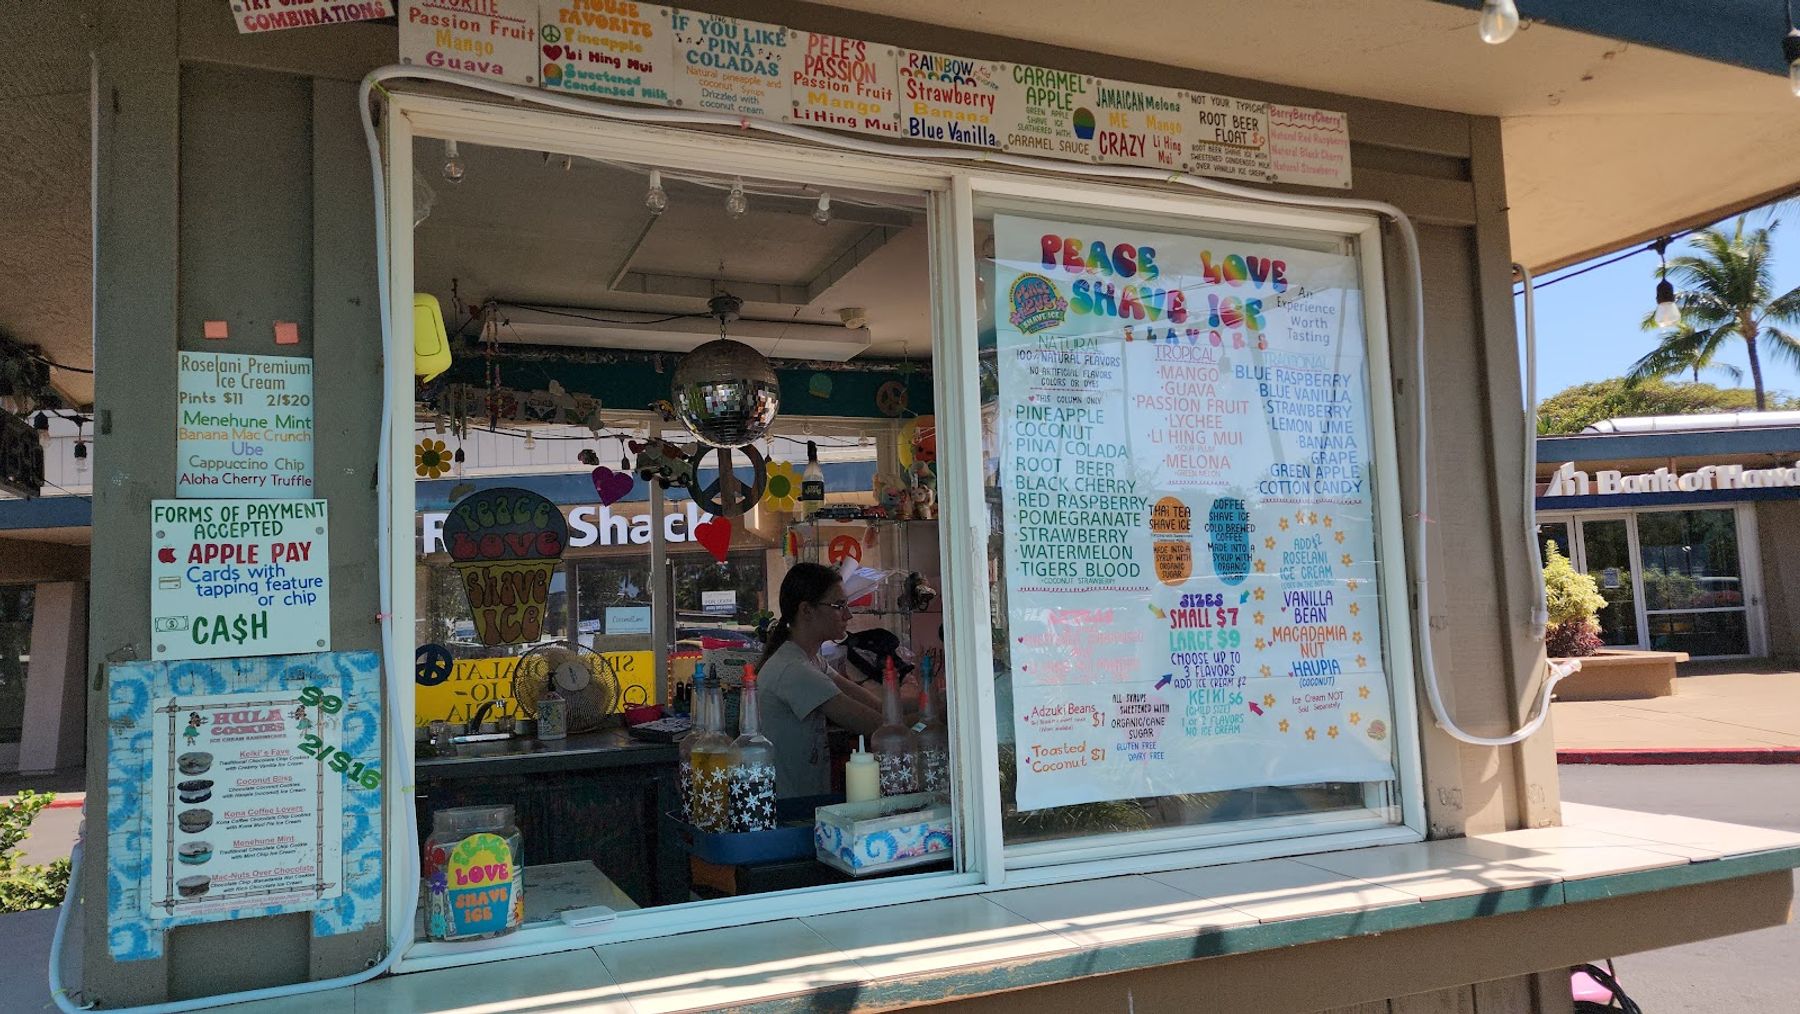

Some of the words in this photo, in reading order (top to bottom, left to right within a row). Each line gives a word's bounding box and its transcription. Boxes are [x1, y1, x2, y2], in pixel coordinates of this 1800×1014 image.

[243, 1, 386, 31] COMBINATIONS
[409, 7, 480, 32] Passion
[490, 19, 535, 41] Fruit
[559, 8, 653, 38] FAVORITE
[672, 15, 689, 31] IF
[698, 19, 737, 39] YOU
[743, 28, 786, 47] LIKE
[435, 29, 494, 56] Mango
[808, 32, 866, 62] PELE'S
[426, 50, 503, 75] Guava
[564, 45, 582, 60] Li
[588, 51, 620, 69] Hing
[627, 58, 654, 73] Mui
[686, 49, 779, 76] COLADAS
[909, 53, 974, 76] RAINBOW
[804, 54, 877, 84] PASSION
[793, 71, 849, 93] Passion
[856, 82, 892, 101] Fruit
[1013, 65, 1086, 93] CARAMEL
[702, 88, 737, 102] Drizzled
[740, 95, 759, 105] with
[808, 91, 881, 116] Mango
[906, 78, 996, 114] Strawberry
[1026, 87, 1073, 111] APPLE
[1096, 87, 1144, 112] JAMAICAN
[913, 102, 989, 123] Banana
[1109, 112, 1127, 129] ME
[1200, 111, 1227, 127] ROOT
[1233, 115, 1259, 131] BEER
[910, 117, 944, 140] Blue
[948, 121, 996, 146] Vanilla
[1215, 128, 1247, 144] FLOAT
[1008, 133, 1054, 150] CARAMEL
[1059, 140, 1089, 155] SAUCE
[1100, 131, 1145, 158] CRAZY
[1041, 234, 1159, 281] PEACE
[1200, 250, 1288, 293] LOVE
[1070, 278, 1188, 324] SHAVE
[1208, 293, 1266, 331] ICE
[1290, 316, 1328, 329] Worth
[1288, 328, 1330, 347] Tasting
[181, 355, 241, 374] Roselani
[249, 358, 311, 375] Premium
[1160, 365, 1220, 382] MANGO
[216, 372, 236, 388] Ice
[241, 373, 286, 390] Cream
[1235, 365, 1272, 381] BLUE
[1276, 369, 1351, 388] RASPBERRY
[1164, 381, 1216, 398] GUAVA
[1260, 383, 1290, 399] BLUE
[1295, 388, 1352, 403] VANILLA
[180, 392, 216, 405] Pints
[223, 392, 243, 405] $11
[266, 394, 310, 407] 2/$20
[1136, 394, 1201, 413] PASSION
[1207, 399, 1249, 414] FRUIT
[1267, 400, 1352, 418] STRAWBERRY
[183, 410, 268, 429] Menehune
[275, 414, 312, 430] Mint
[1016, 404, 1104, 424] PINEAPPLE
[1169, 414, 1224, 429] LYCHEE
[179, 428, 229, 441] Banana
[232, 428, 261, 441] Mac
[263, 429, 311, 442] Crunch
[1015, 421, 1094, 441] COCONUT
[231, 441, 264, 456] Ube
[1016, 438, 1056, 452] PINA
[1065, 442, 1129, 459] COLADA
[1300, 435, 1357, 449] BANANA
[189, 455, 268, 471] Cappuccino
[274, 457, 305, 472] Chip
[1016, 457, 1062, 472] ROOT
[1075, 460, 1115, 477] BEER
[1166, 454, 1231, 470] MELONA
[1271, 463, 1311, 478] GREEN
[1316, 465, 1360, 479] APPLE
[179, 472, 219, 485] Aloha
[222, 472, 267, 487] Cherry
[270, 474, 312, 487] Truffle
[1016, 475, 1069, 491] BLACK
[1075, 477, 1136, 494] CHERRY
[1259, 480, 1310, 494] COTTON
[1314, 480, 1363, 494] CANDY
[1596, 467, 1679, 494] Bank
[1679, 465, 1717, 492] of
[1018, 492, 1049, 507] RED
[1057, 493, 1149, 511] RASPBERRY
[154, 506, 213, 523] FORMS
[220, 506, 240, 522] OF
[247, 501, 326, 520] PAYMENT
[1019, 510, 1141, 527] POMEGRANATE
[194, 521, 283, 540] ACCEPTED
[568, 502, 714, 548] Shack
[1205, 523, 1223, 532] COLD
[1018, 527, 1129, 544] STRAWBERRY
[187, 543, 259, 564] APPLE
[271, 541, 312, 563] PAY
[1020, 544, 1133, 560] WATERMELON
[1283, 551, 1328, 565] ROSELANI
[186, 564, 240, 582] Cards
[248, 563, 285, 580] with
[1020, 561, 1078, 577] TIGERS
[1086, 562, 1140, 578] BLOOD
[196, 579, 258, 599] tapping
[265, 576, 323, 591] feature
[258, 596, 275, 606] or
[284, 590, 317, 606] chip
[1180, 593, 1224, 608] SIZES
[1283, 590, 1334, 607] VANILLA
[1170, 608, 1212, 628] SMALL
[1216, 607, 1239, 628] $7
[1295, 607, 1327, 624] BEAN
[192, 610, 268, 645] CA$H
[1272, 626, 1347, 643] MACADAMIA
[1169, 630, 1214, 652] LARGE
[1216, 629, 1241, 650] $9
[1300, 642, 1325, 658] NUT
[1292, 660, 1341, 676] HAUPIA
[212, 708, 284, 725] HULA
[1032, 704, 1066, 718] Adzuki
[1068, 703, 1096, 715] Beans
[211, 723, 285, 736] COOKIES
[1032, 740, 1086, 758] Toasted
[1090, 747, 1106, 762] $1
[1141, 741, 1157, 750] FREE
[1032, 757, 1088, 773] Coconut
[1150, 752, 1164, 760] FREE
[224, 810, 246, 819] Kona
[247, 807, 274, 817] Coffee
[233, 838, 275, 848] Menehune
[277, 835, 295, 844] Mint
[252, 869, 272, 878] Over
[274, 864, 314, 874] Chocolate
[455, 863, 508, 885] LOVE
[456, 888, 507, 908] SHAVE
